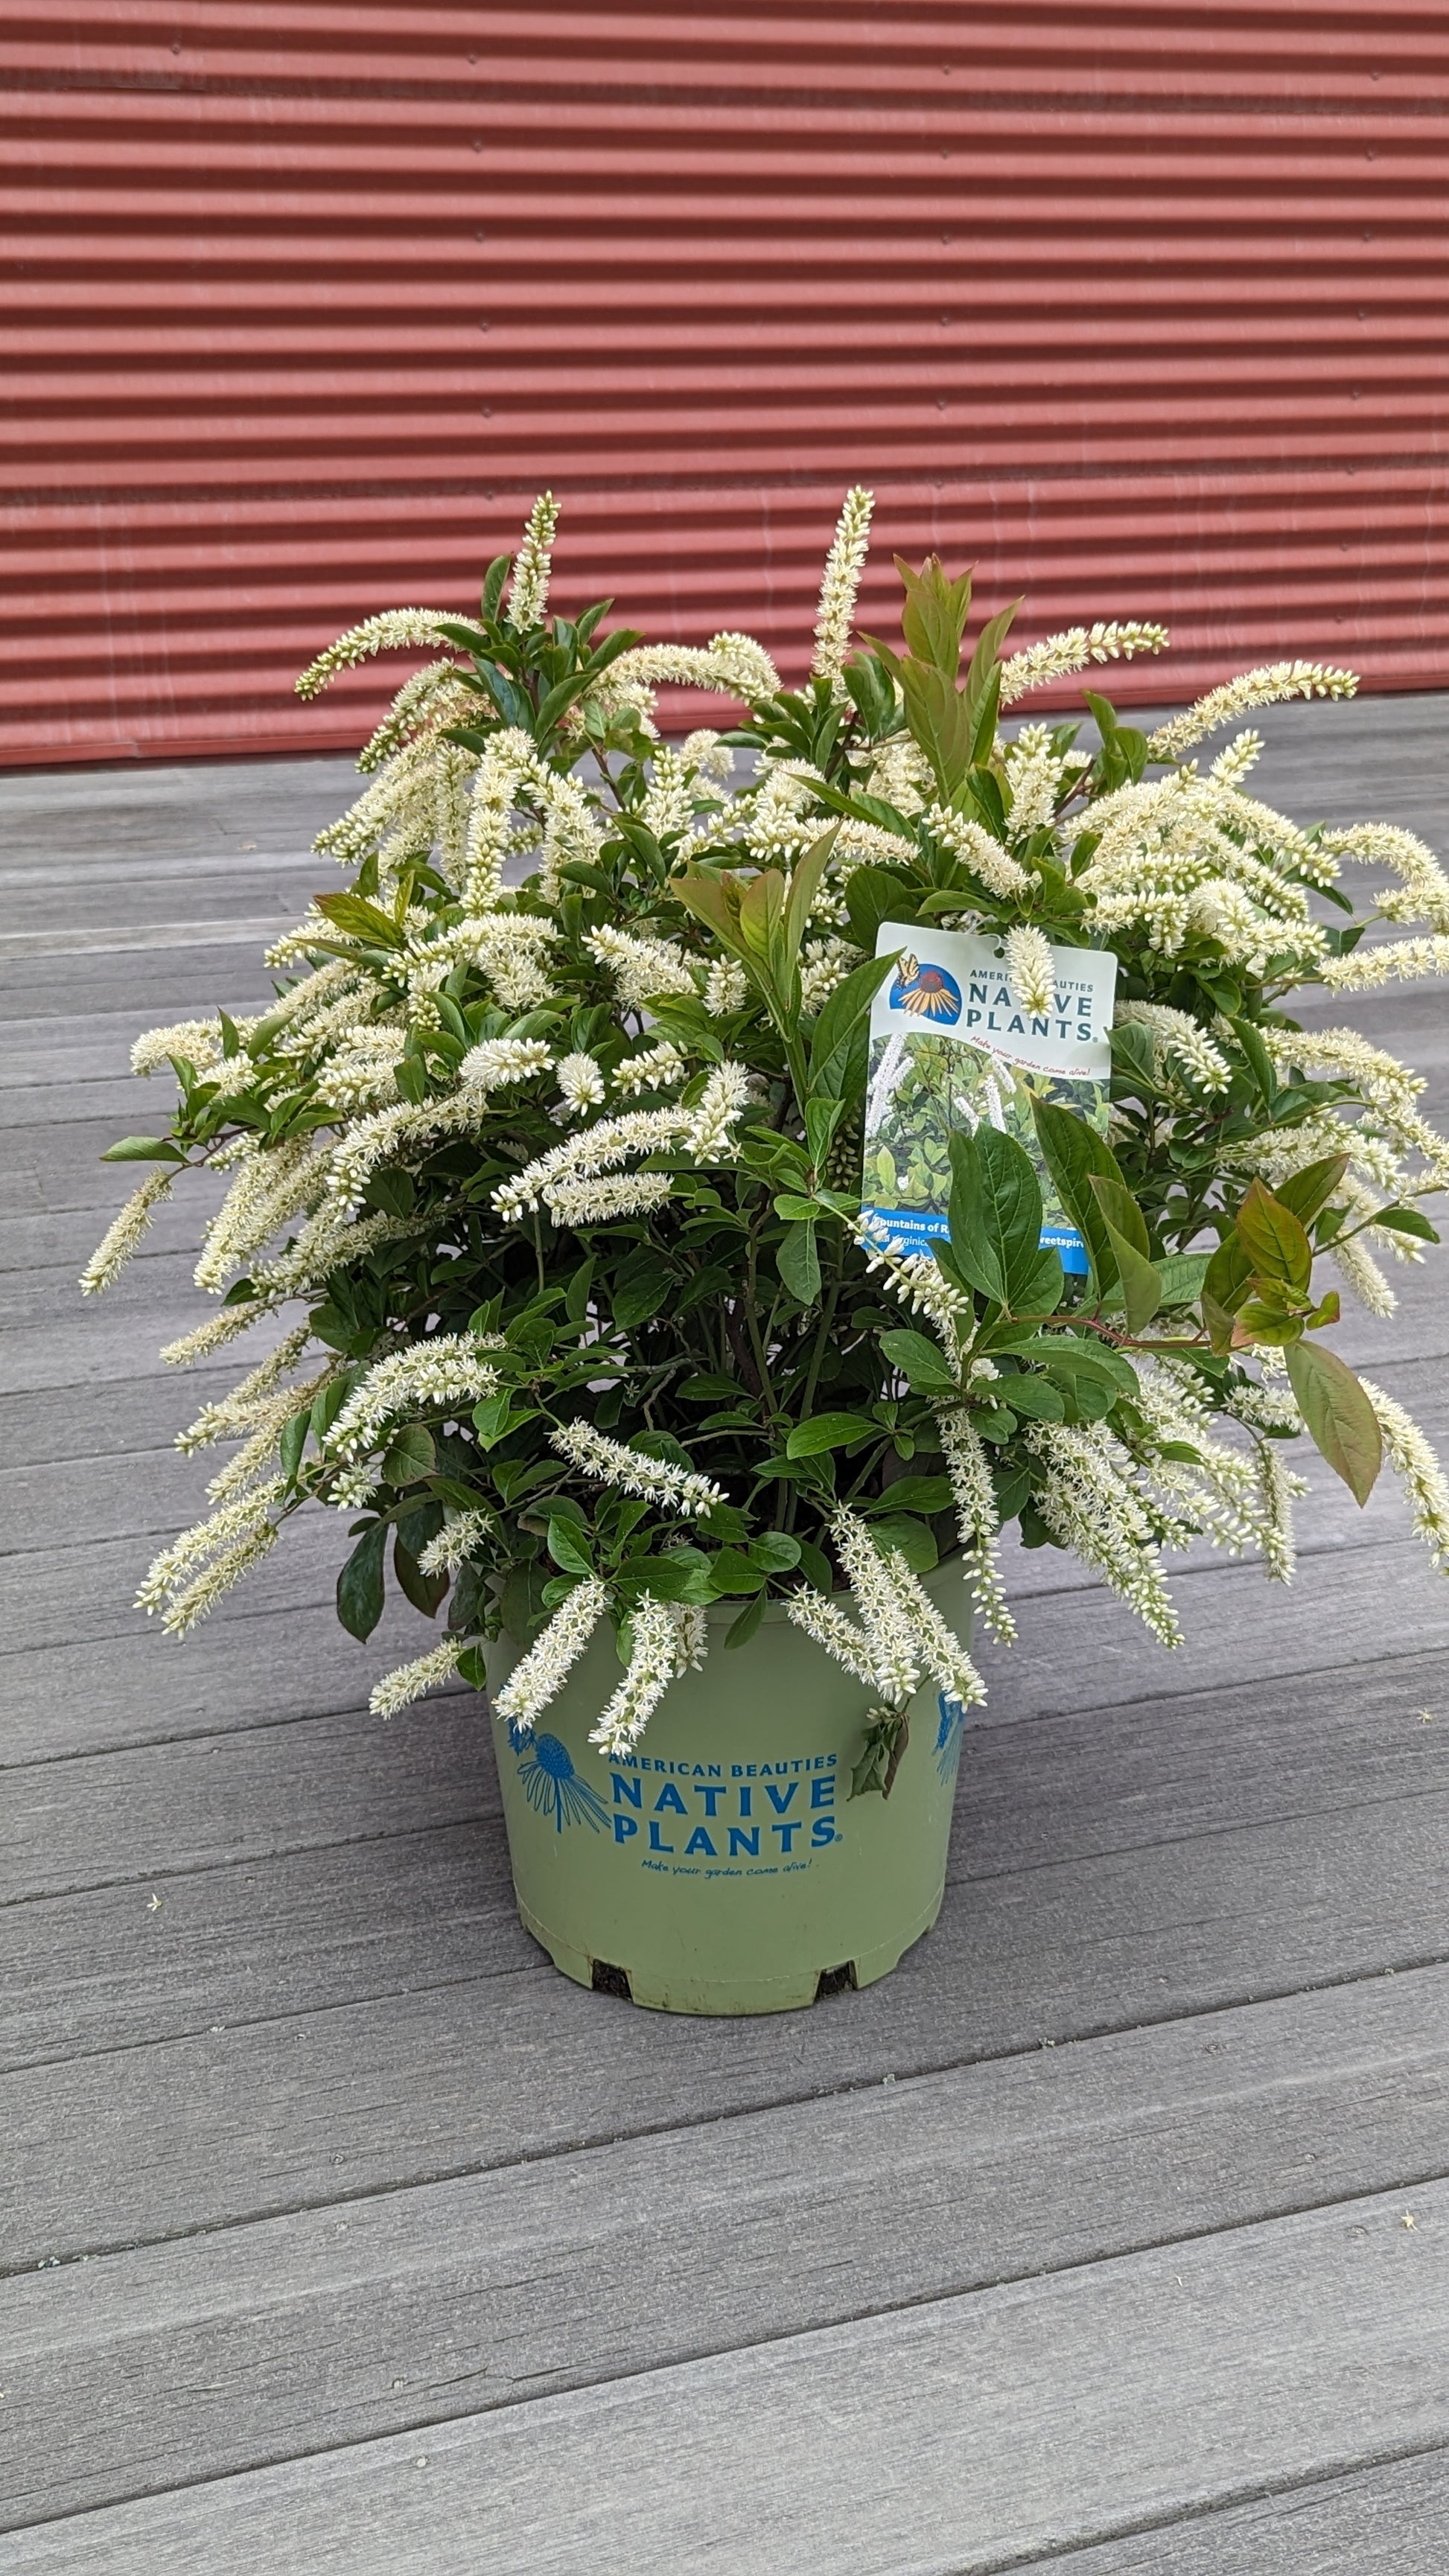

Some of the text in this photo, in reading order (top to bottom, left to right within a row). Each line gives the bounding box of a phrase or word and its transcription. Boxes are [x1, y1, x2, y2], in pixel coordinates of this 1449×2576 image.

[969, 969, 1094, 992] AMERI AUTIES
[969, 983, 1092, 1017] NAVE
[970, 1036, 1091, 1076] Make your garden come alive!
[880, 1219, 926, 1231] ountains
[927, 1222, 940, 1233] of
[608, 1753, 838, 1777] AMERICAN BEAUTIES
[609, 1772, 836, 1817] NATIVE
[641, 1858, 812, 1879] Make your garden come alive!
